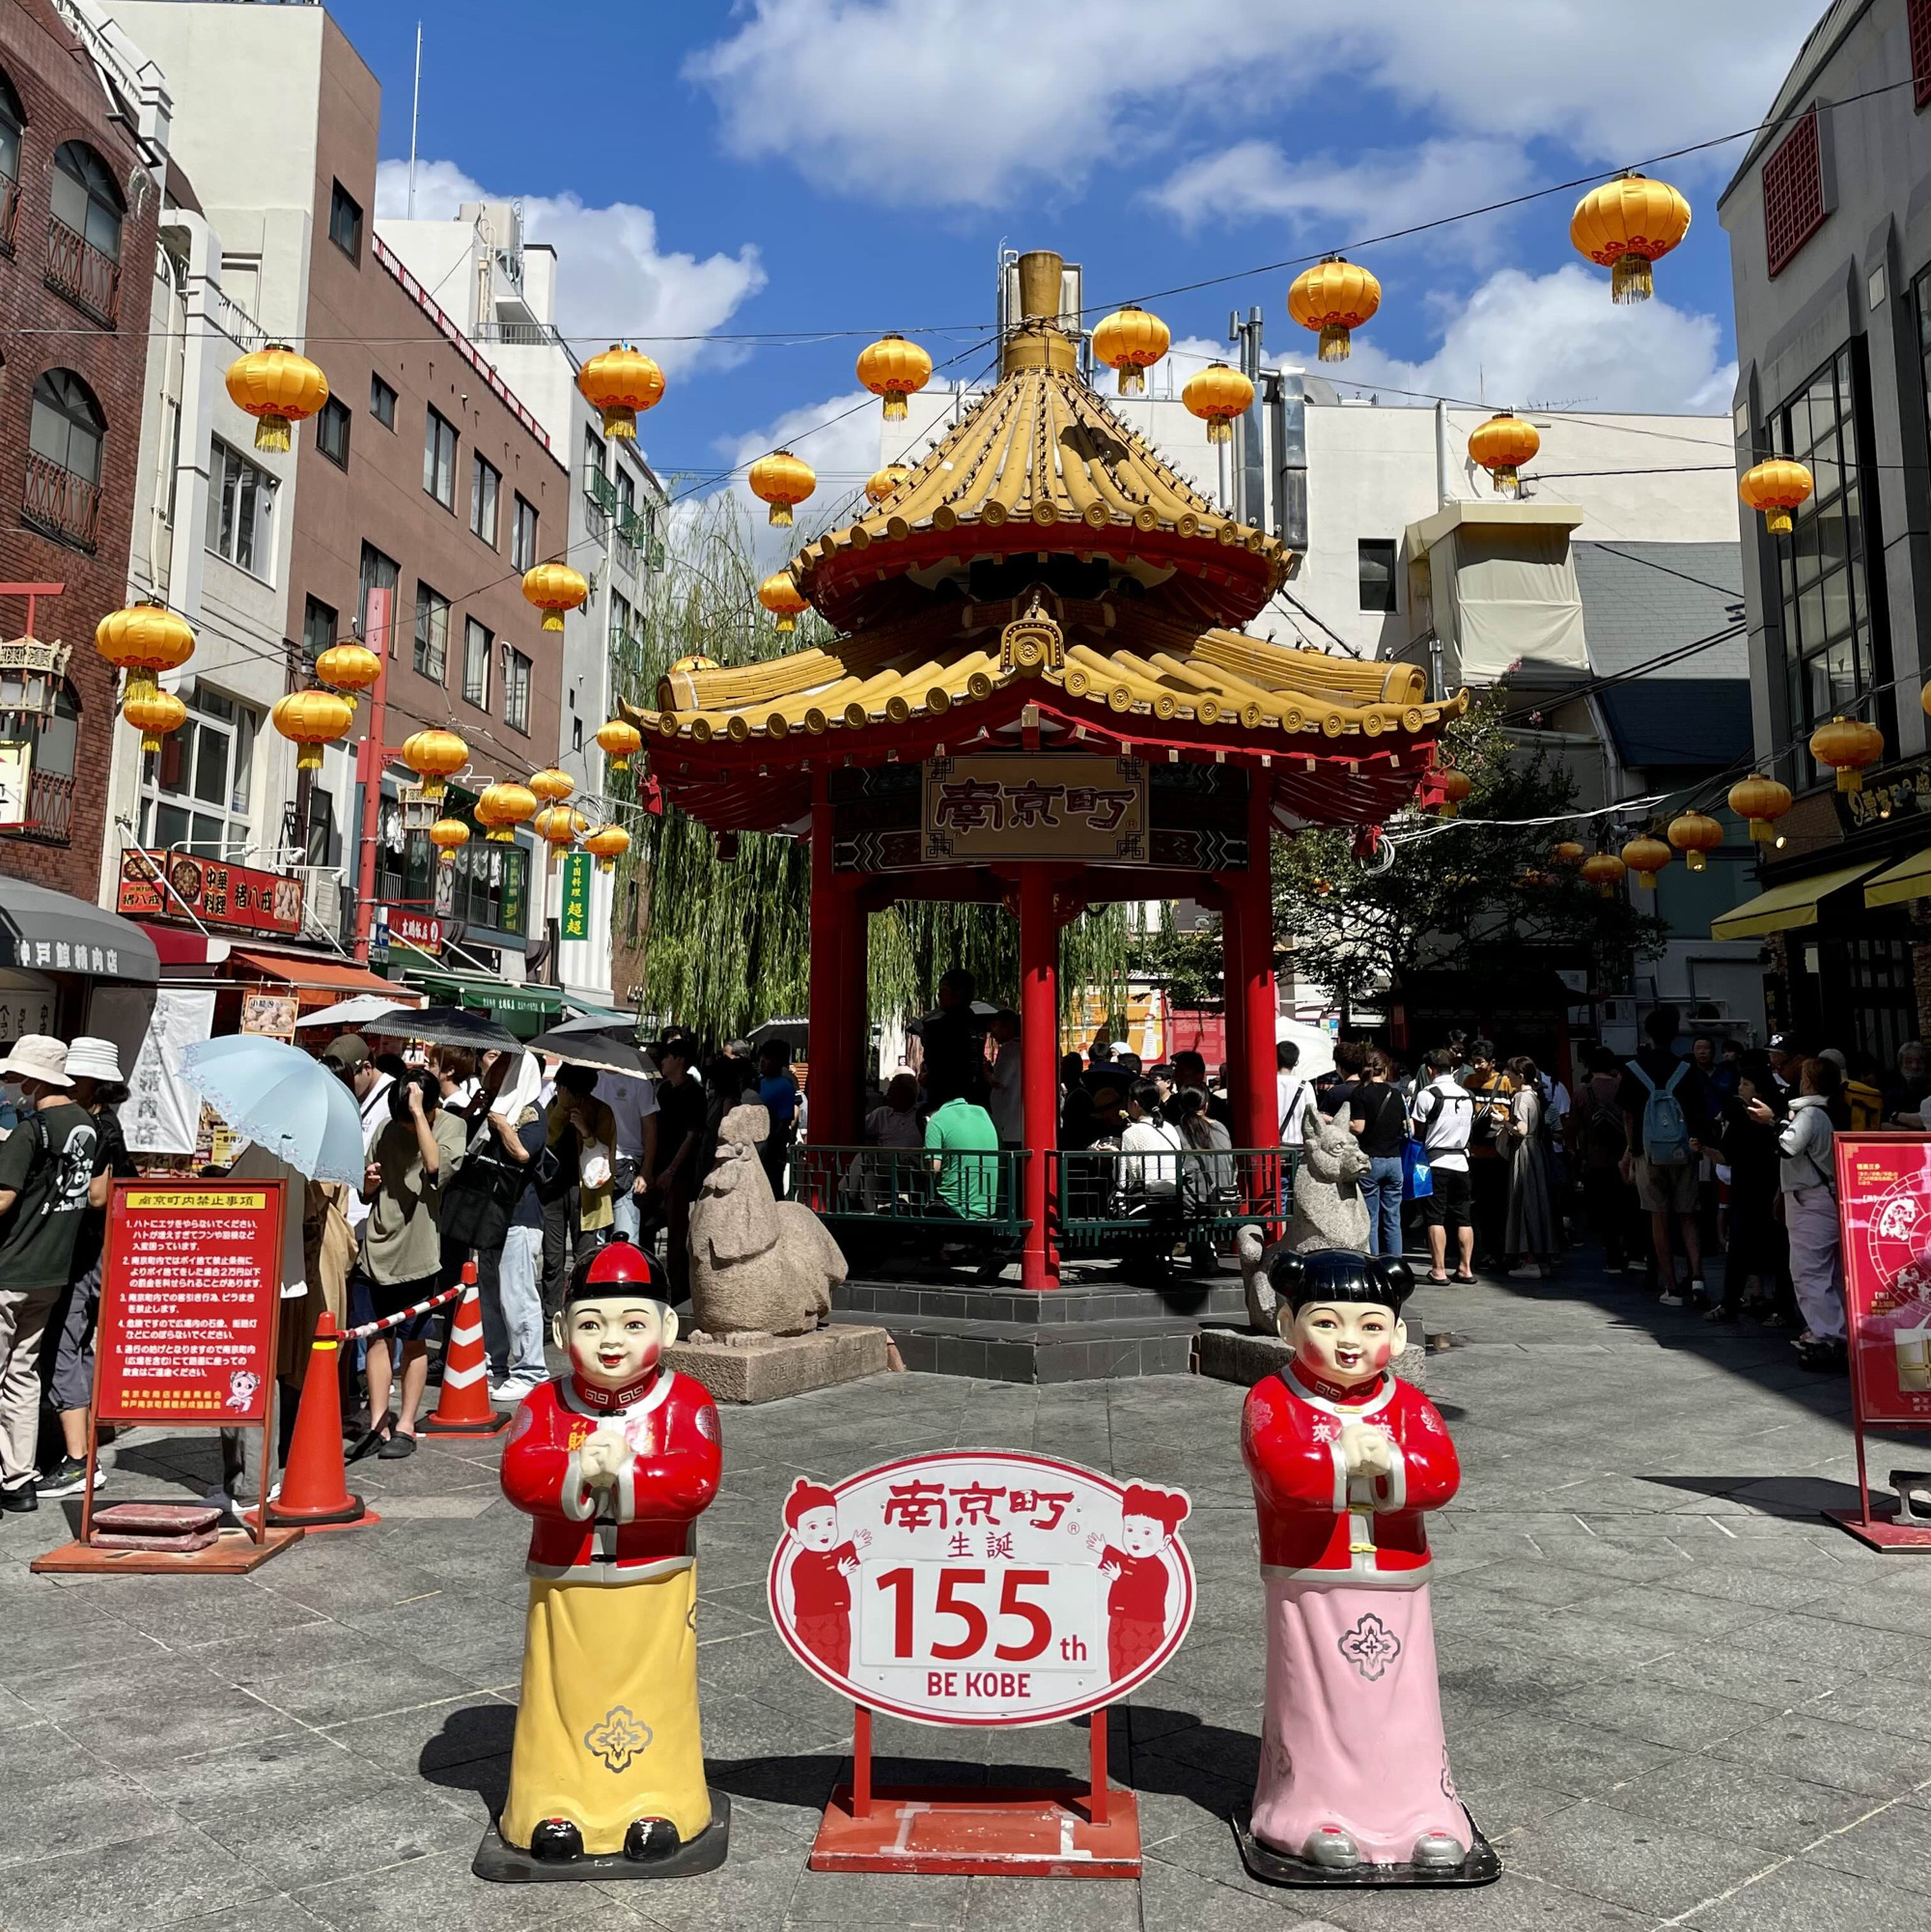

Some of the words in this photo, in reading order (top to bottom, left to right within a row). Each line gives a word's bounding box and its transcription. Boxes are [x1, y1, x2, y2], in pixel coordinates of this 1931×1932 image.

[935, 777, 1137, 834] 南京町
[206, 865, 228, 890] 中華
[204, 890, 227, 915] 料理
[138, 1195, 254, 1206] 南京町内禁止事項
[567, 1432, 588, 1451] 財
[1312, 1423, 1333, 1442] 來
[883, 1479, 1076, 1533] 南京町
[947, 1530, 1016, 1559] 生誕
[876, 1567, 1052, 1662] 155
[1060, 1635, 1087, 1661] th
[928, 1672, 957, 1697] BE
[966, 1672, 1031, 1698] KOBE
